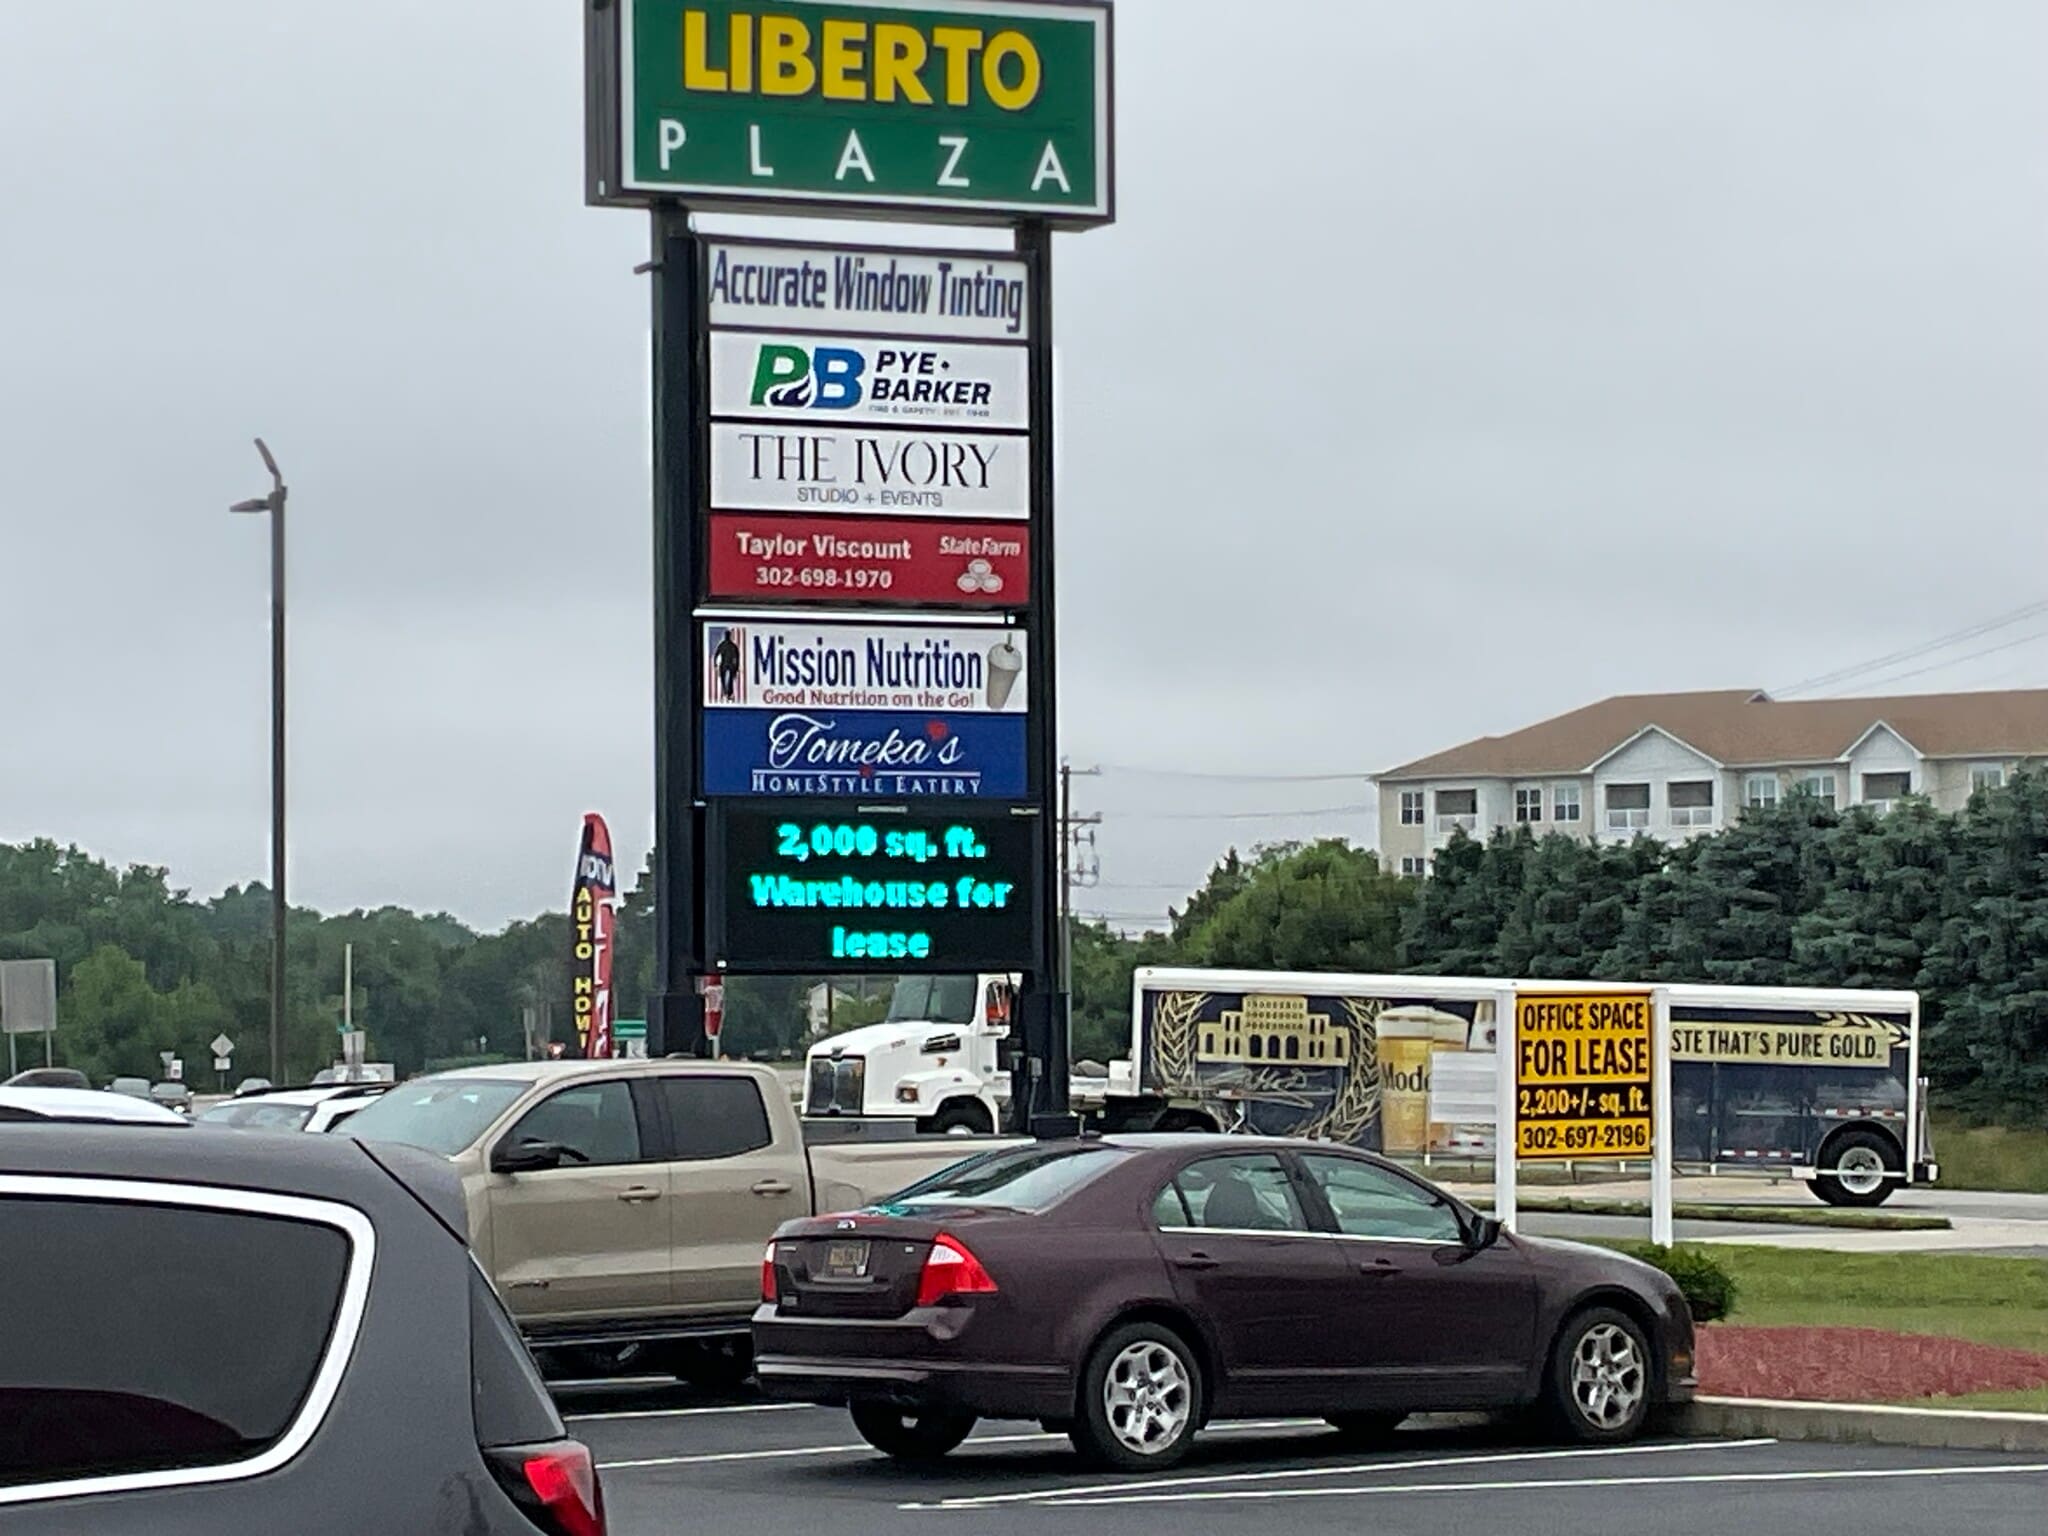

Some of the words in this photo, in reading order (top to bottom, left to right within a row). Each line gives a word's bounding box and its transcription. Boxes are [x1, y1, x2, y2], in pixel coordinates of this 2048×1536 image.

[683, 9, 1042, 111] LIBERTO
[658, 118, 1071, 193] PLAZA
[709, 249, 828, 309] Accurate
[834, 255, 933, 315] Window
[938, 262, 1024, 333] Tinting
[870, 377, 992, 405] BARKER
[738, 433, 837, 483] THE
[854, 437, 1000, 489] IVORY
[797, 487, 859, 505] STUDIO
[880, 492, 943, 507] EVENTS
[736, 532, 806, 560] Taylor
[812, 534, 911, 560] Viscount
[755, 566, 893, 590] 302-698-1970
[753, 635, 856, 688] Mission
[866, 637, 982, 689] Nutrition
[762, 688, 806, 706] Good
[810, 690, 887, 708] Nutrition
[891, 694, 913, 708] on
[917, 690, 944, 708] the
[947, 691, 974, 710] Go!
[895, 775, 982, 795] EATERY
[776, 823, 878, 862] 2,000
[885, 830, 938, 863] sq.
[944, 825, 987, 858] ft.
[750, 874, 949, 908] Warehouse
[954, 876, 1014, 908] for
[575, 886, 593, 960] AUTO
[831, 925, 931, 959] lease
[1523, 1003, 1585, 1032] OFFICE
[1588, 1002, 1645, 1031] SPACE
[1520, 1038, 1568, 1077] FOR
[1574, 1038, 1647, 1075] LEASE
[1708, 1029, 1770, 1057] THAT'S
[1776, 1034, 1823, 1058] PURE
[1599, 1092, 1626, 1118] sq.
[1629, 1085, 1650, 1112] ft.
[1523, 1124, 1646, 1149] 302-697-2196
